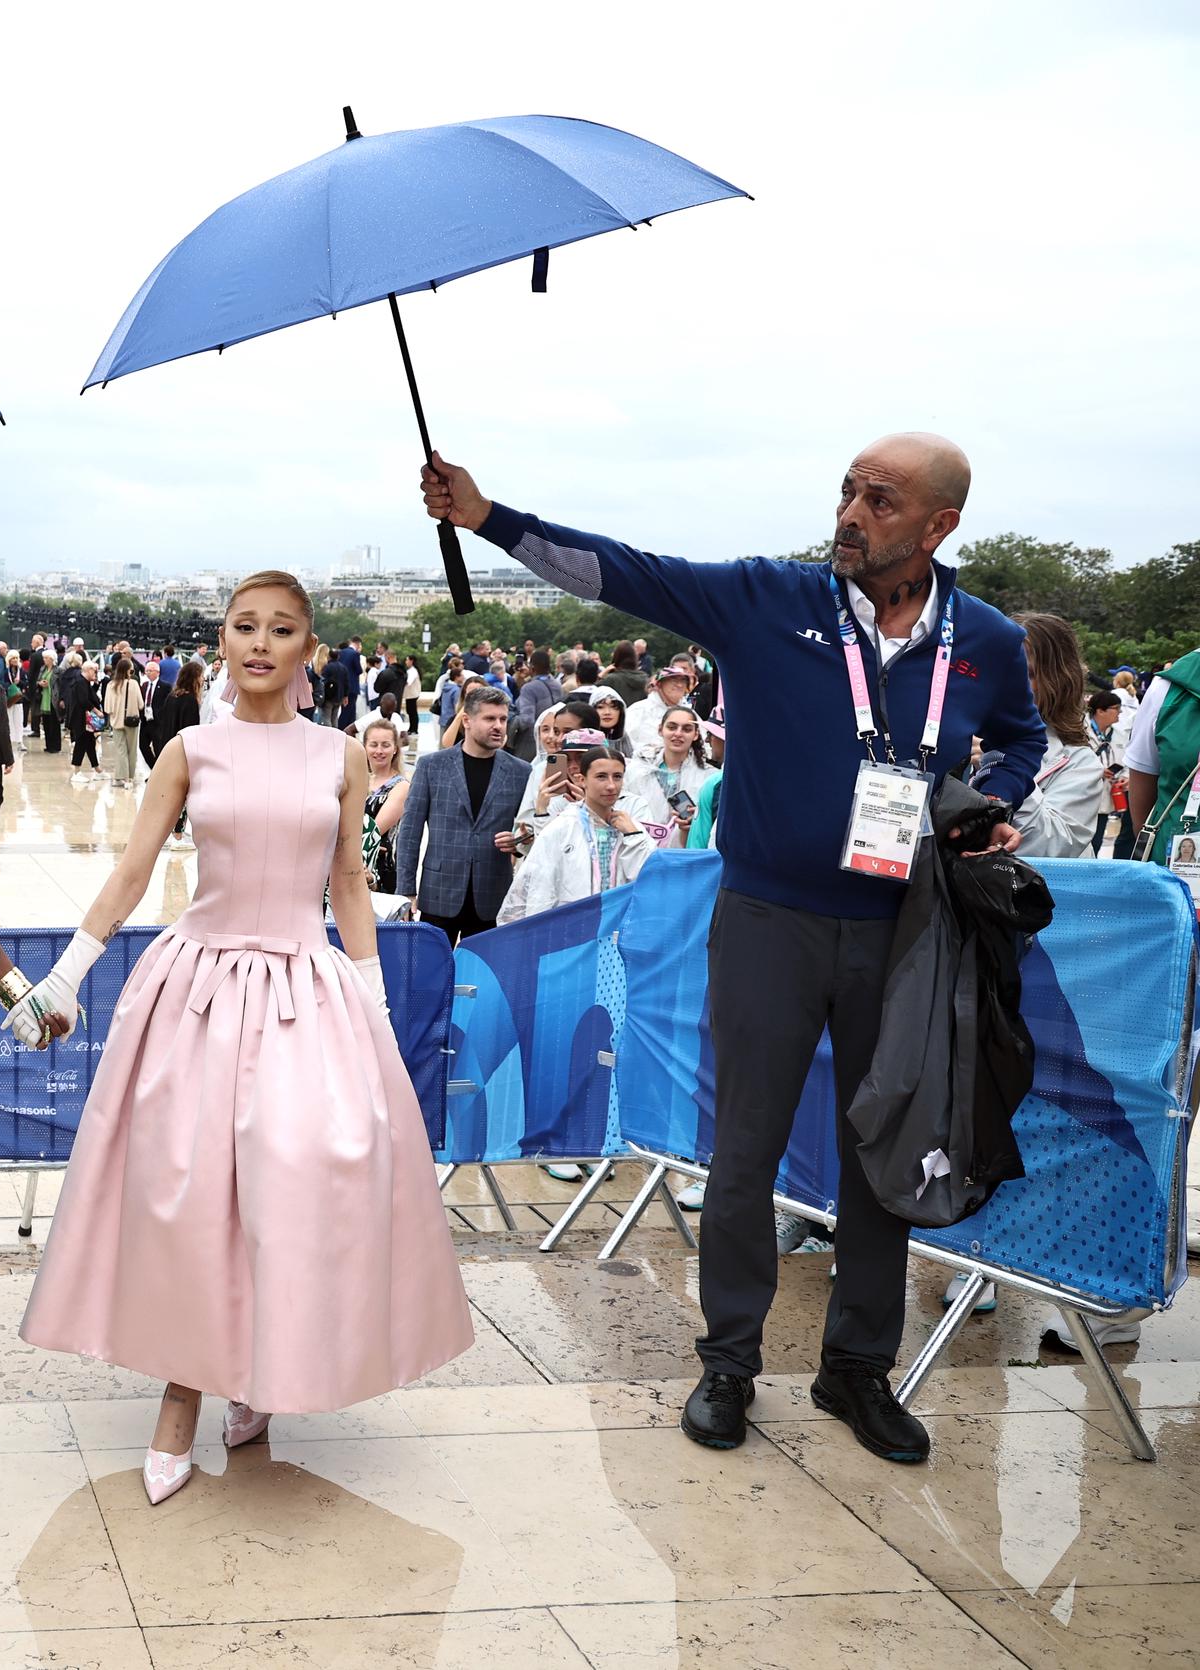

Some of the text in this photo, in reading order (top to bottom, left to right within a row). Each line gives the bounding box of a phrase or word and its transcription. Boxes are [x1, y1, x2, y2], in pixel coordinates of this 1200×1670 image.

[872, 860, 897, 873] 4 6
[992, 863, 1016, 874] GALVIN
